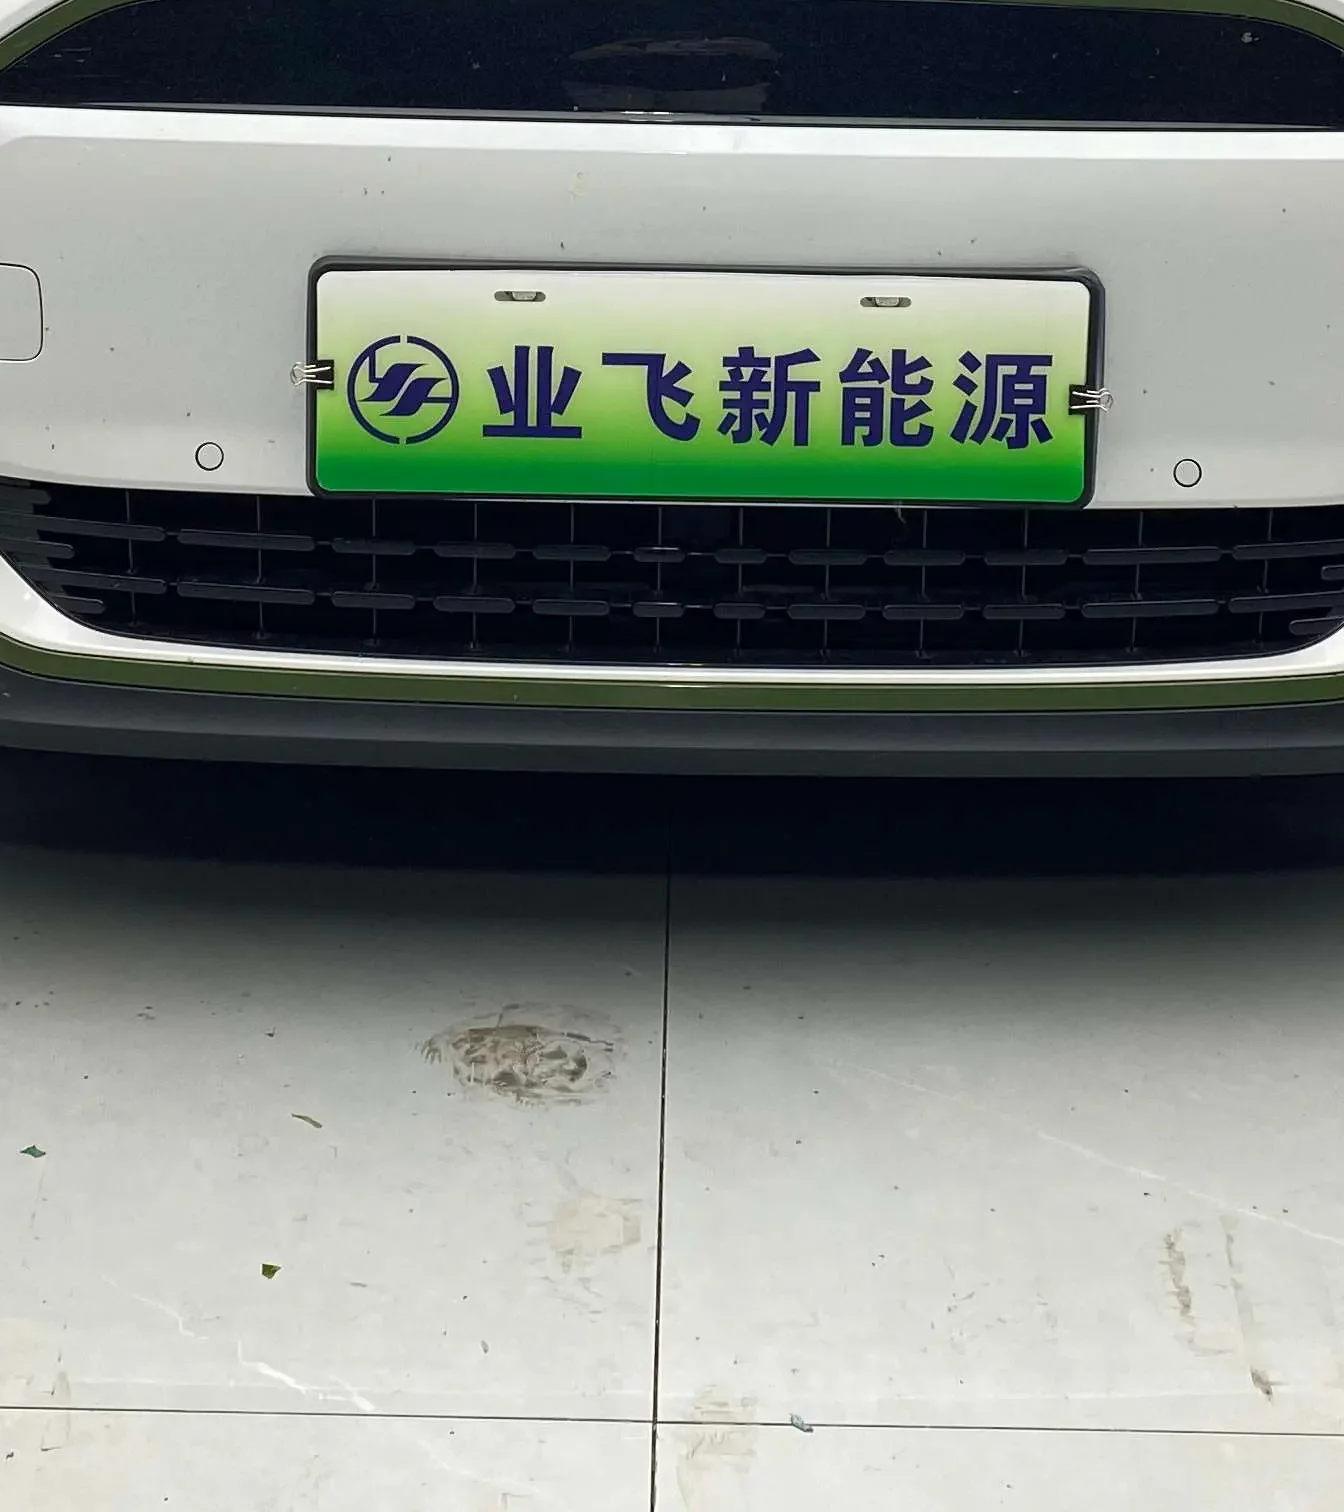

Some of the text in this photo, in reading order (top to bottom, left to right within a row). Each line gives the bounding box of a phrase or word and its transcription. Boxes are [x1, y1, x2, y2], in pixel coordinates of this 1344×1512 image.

[482, 345, 1054, 450] 业飞新能源
